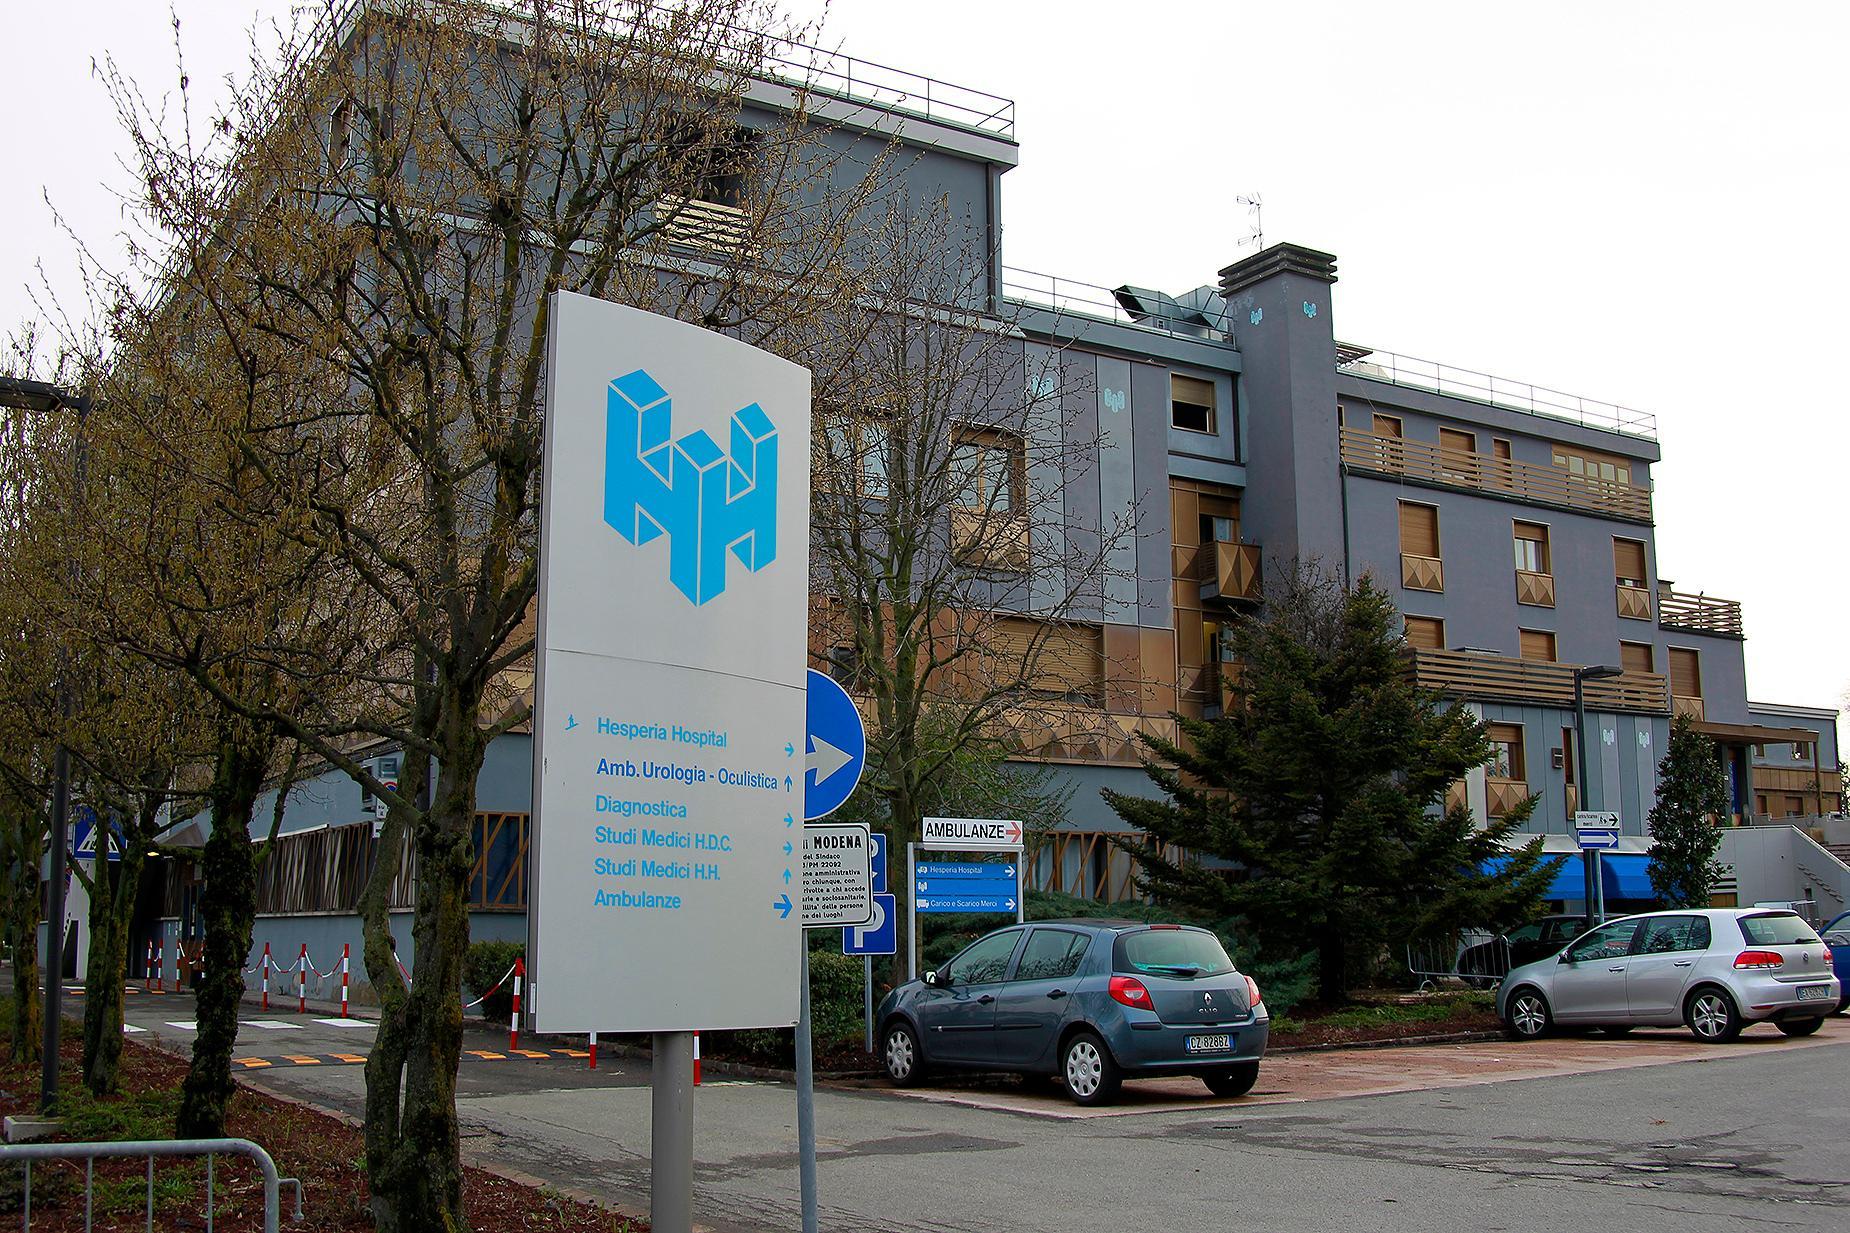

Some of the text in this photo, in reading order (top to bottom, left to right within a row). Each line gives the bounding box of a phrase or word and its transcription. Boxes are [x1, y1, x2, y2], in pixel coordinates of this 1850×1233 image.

[597, 717, 727, 748] Hesperia Hospital
[643, 761, 706, 785] Urologia
[718, 768, 778, 789] Oculistica
[596, 795, 687, 817] Diagnostica
[595, 826, 732, 851] Studi Medici H.D.C.
[925, 822, 1005, 838] AMBULANZE
[813, 836, 862, 849] MODENA
[594, 857, 721, 880] Studi Medici H.H.
[930, 866, 957, 874] Hesperia
[594, 889, 681, 908] Ambulanze
